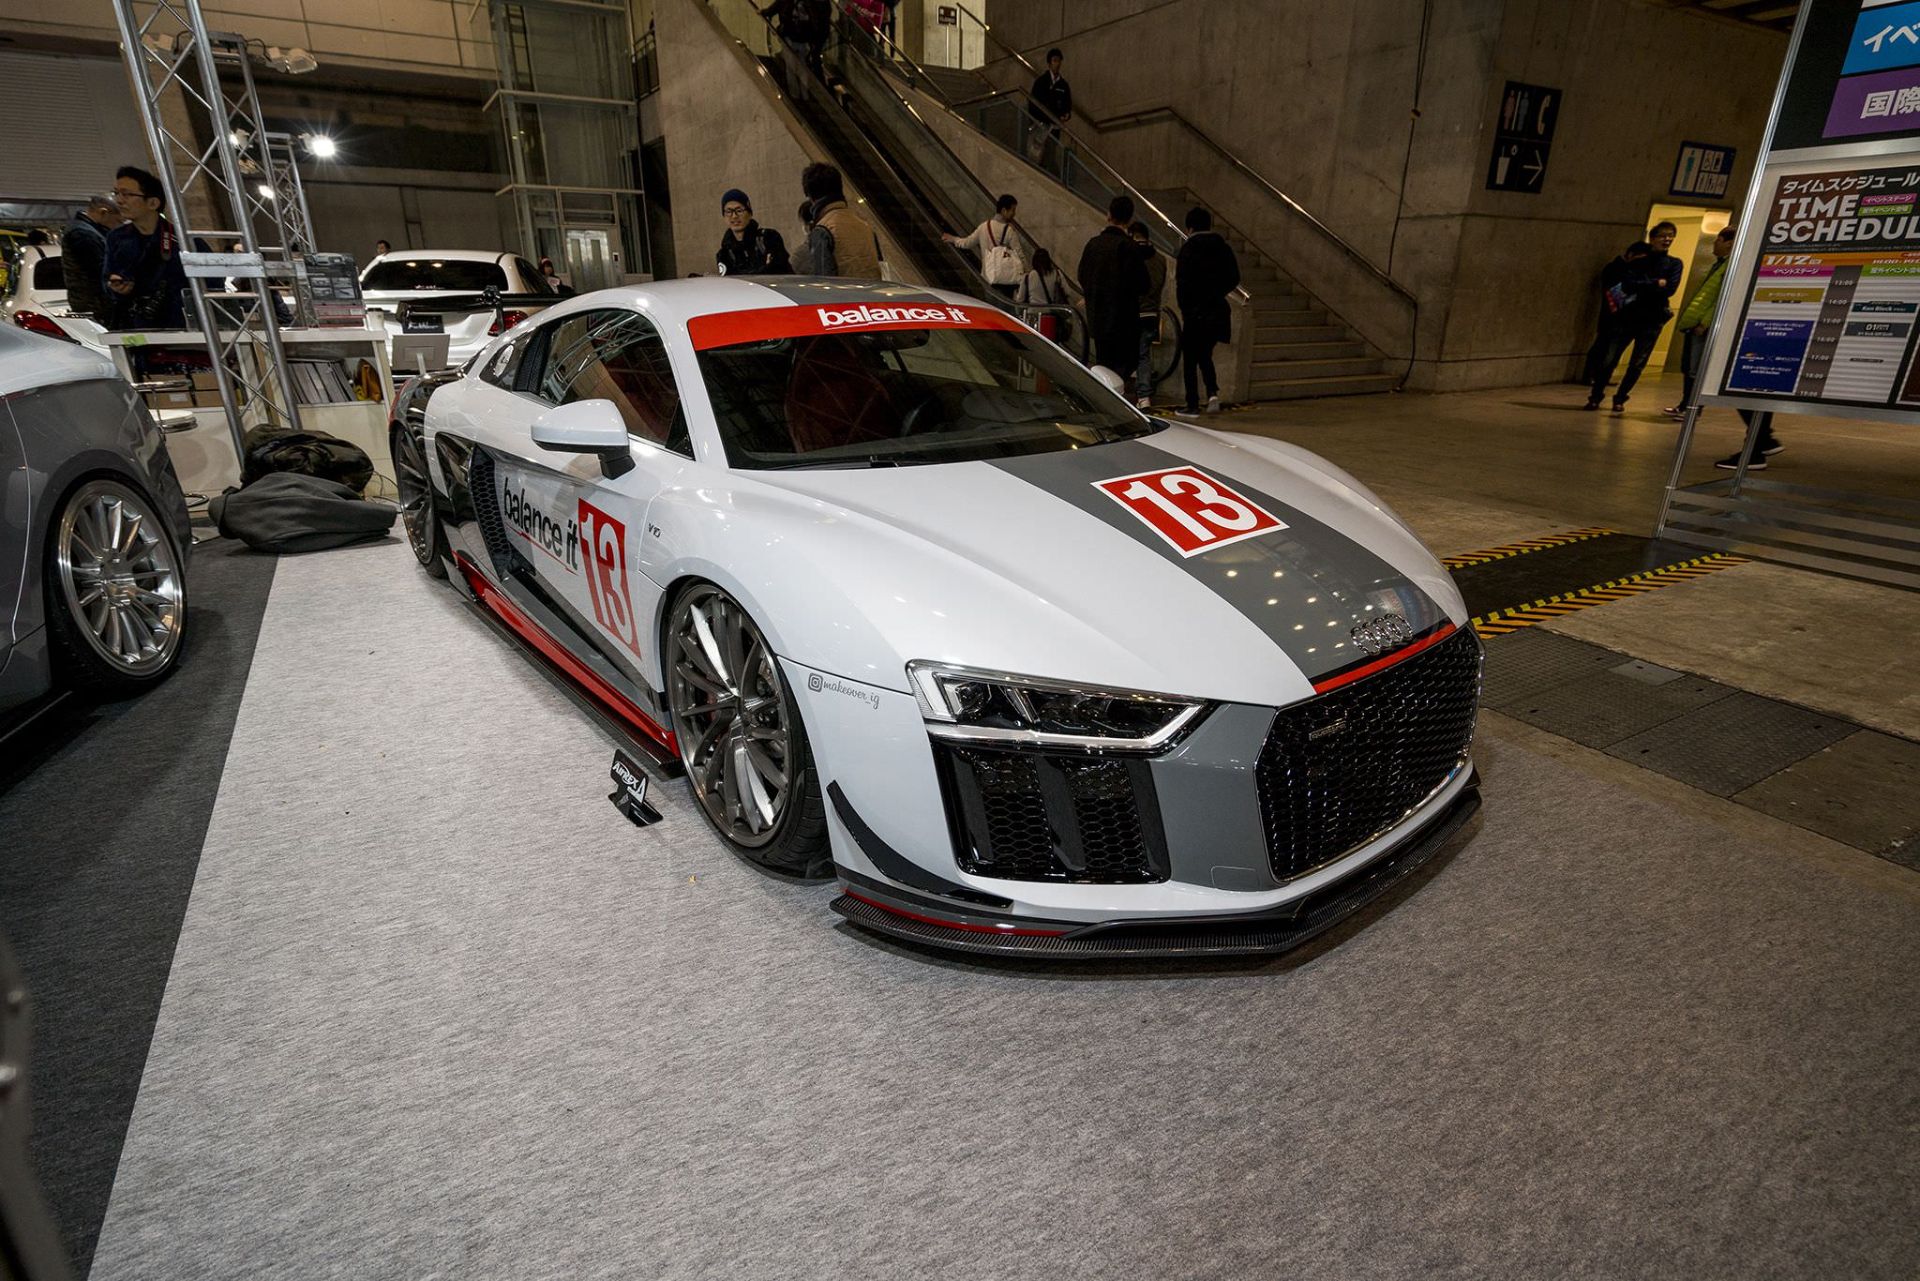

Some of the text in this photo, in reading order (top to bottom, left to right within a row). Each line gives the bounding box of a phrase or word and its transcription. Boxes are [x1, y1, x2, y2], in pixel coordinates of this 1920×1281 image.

[1783, 172, 1920, 195] タイムスケジュール
[1778, 193, 1860, 220] TIME
[1769, 216, 1920, 244] SCHEDUL
[817, 305, 971, 327] balance it
[1122, 474, 1258, 542] 13
[504, 477, 578, 571] balance it
[581, 512, 633, 645] 13
[823, 680, 880, 710] makeover_ig
